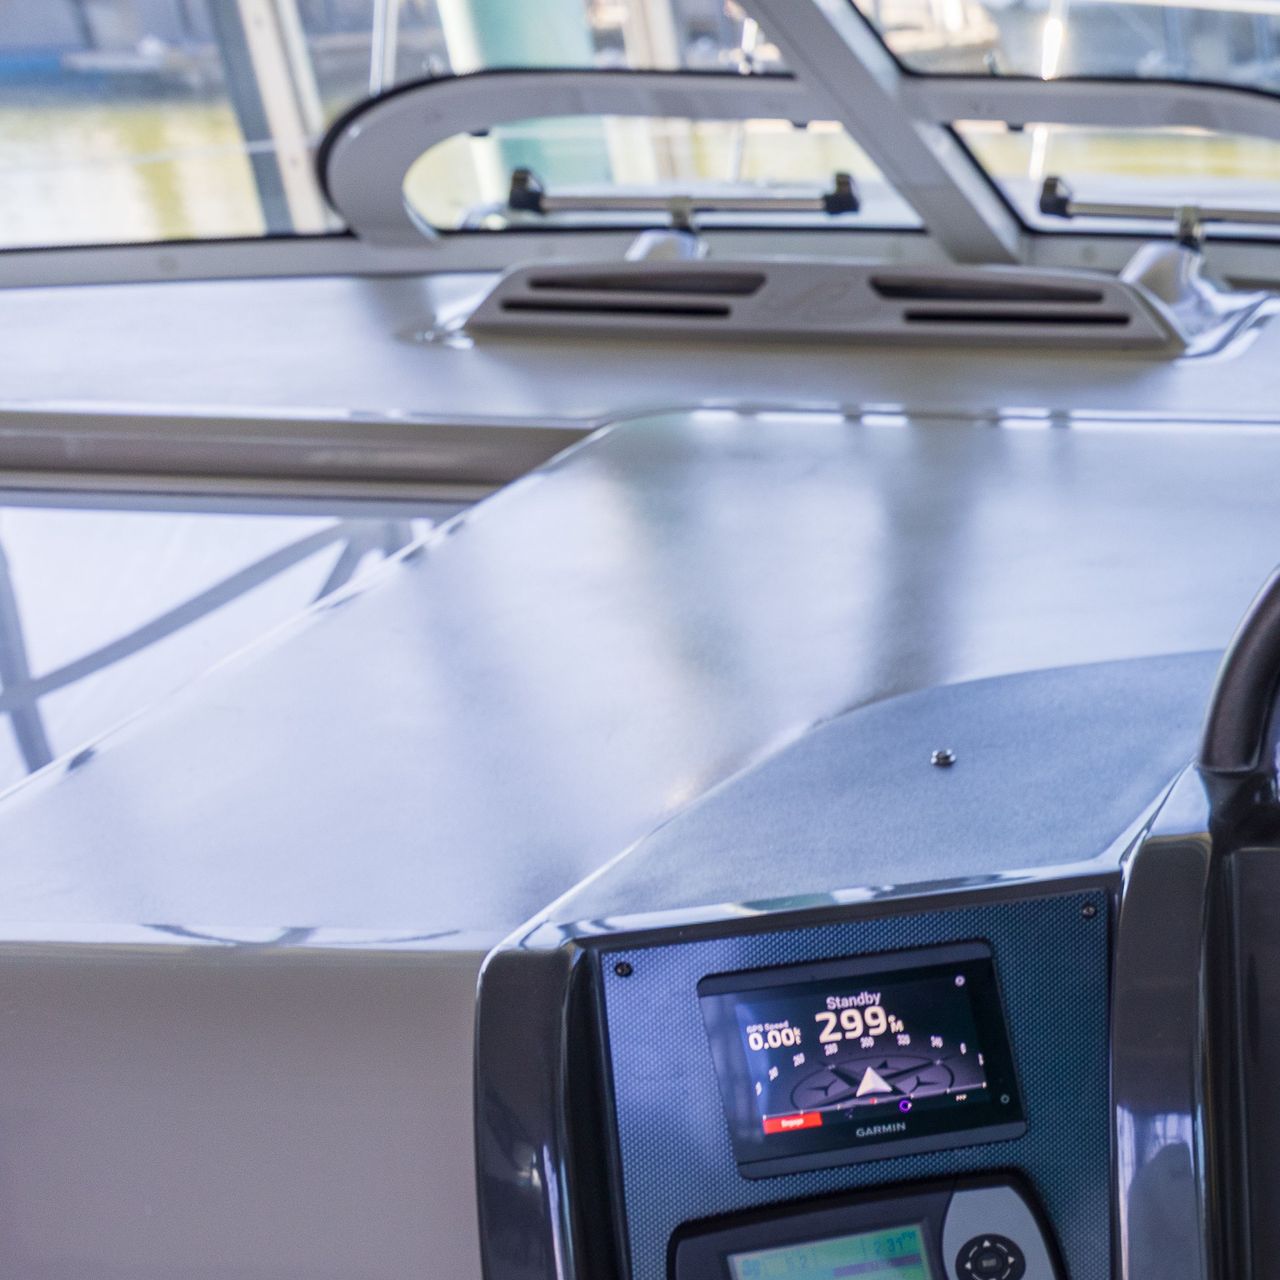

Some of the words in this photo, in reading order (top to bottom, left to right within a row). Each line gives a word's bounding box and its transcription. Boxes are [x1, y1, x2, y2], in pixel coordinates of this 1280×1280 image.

[826, 991, 881, 1011] Standby
[815, 1005, 889, 1043] 299
[749, 1029, 794, 1051] 0.00
[856, 1122, 906, 1137] GARMIN
